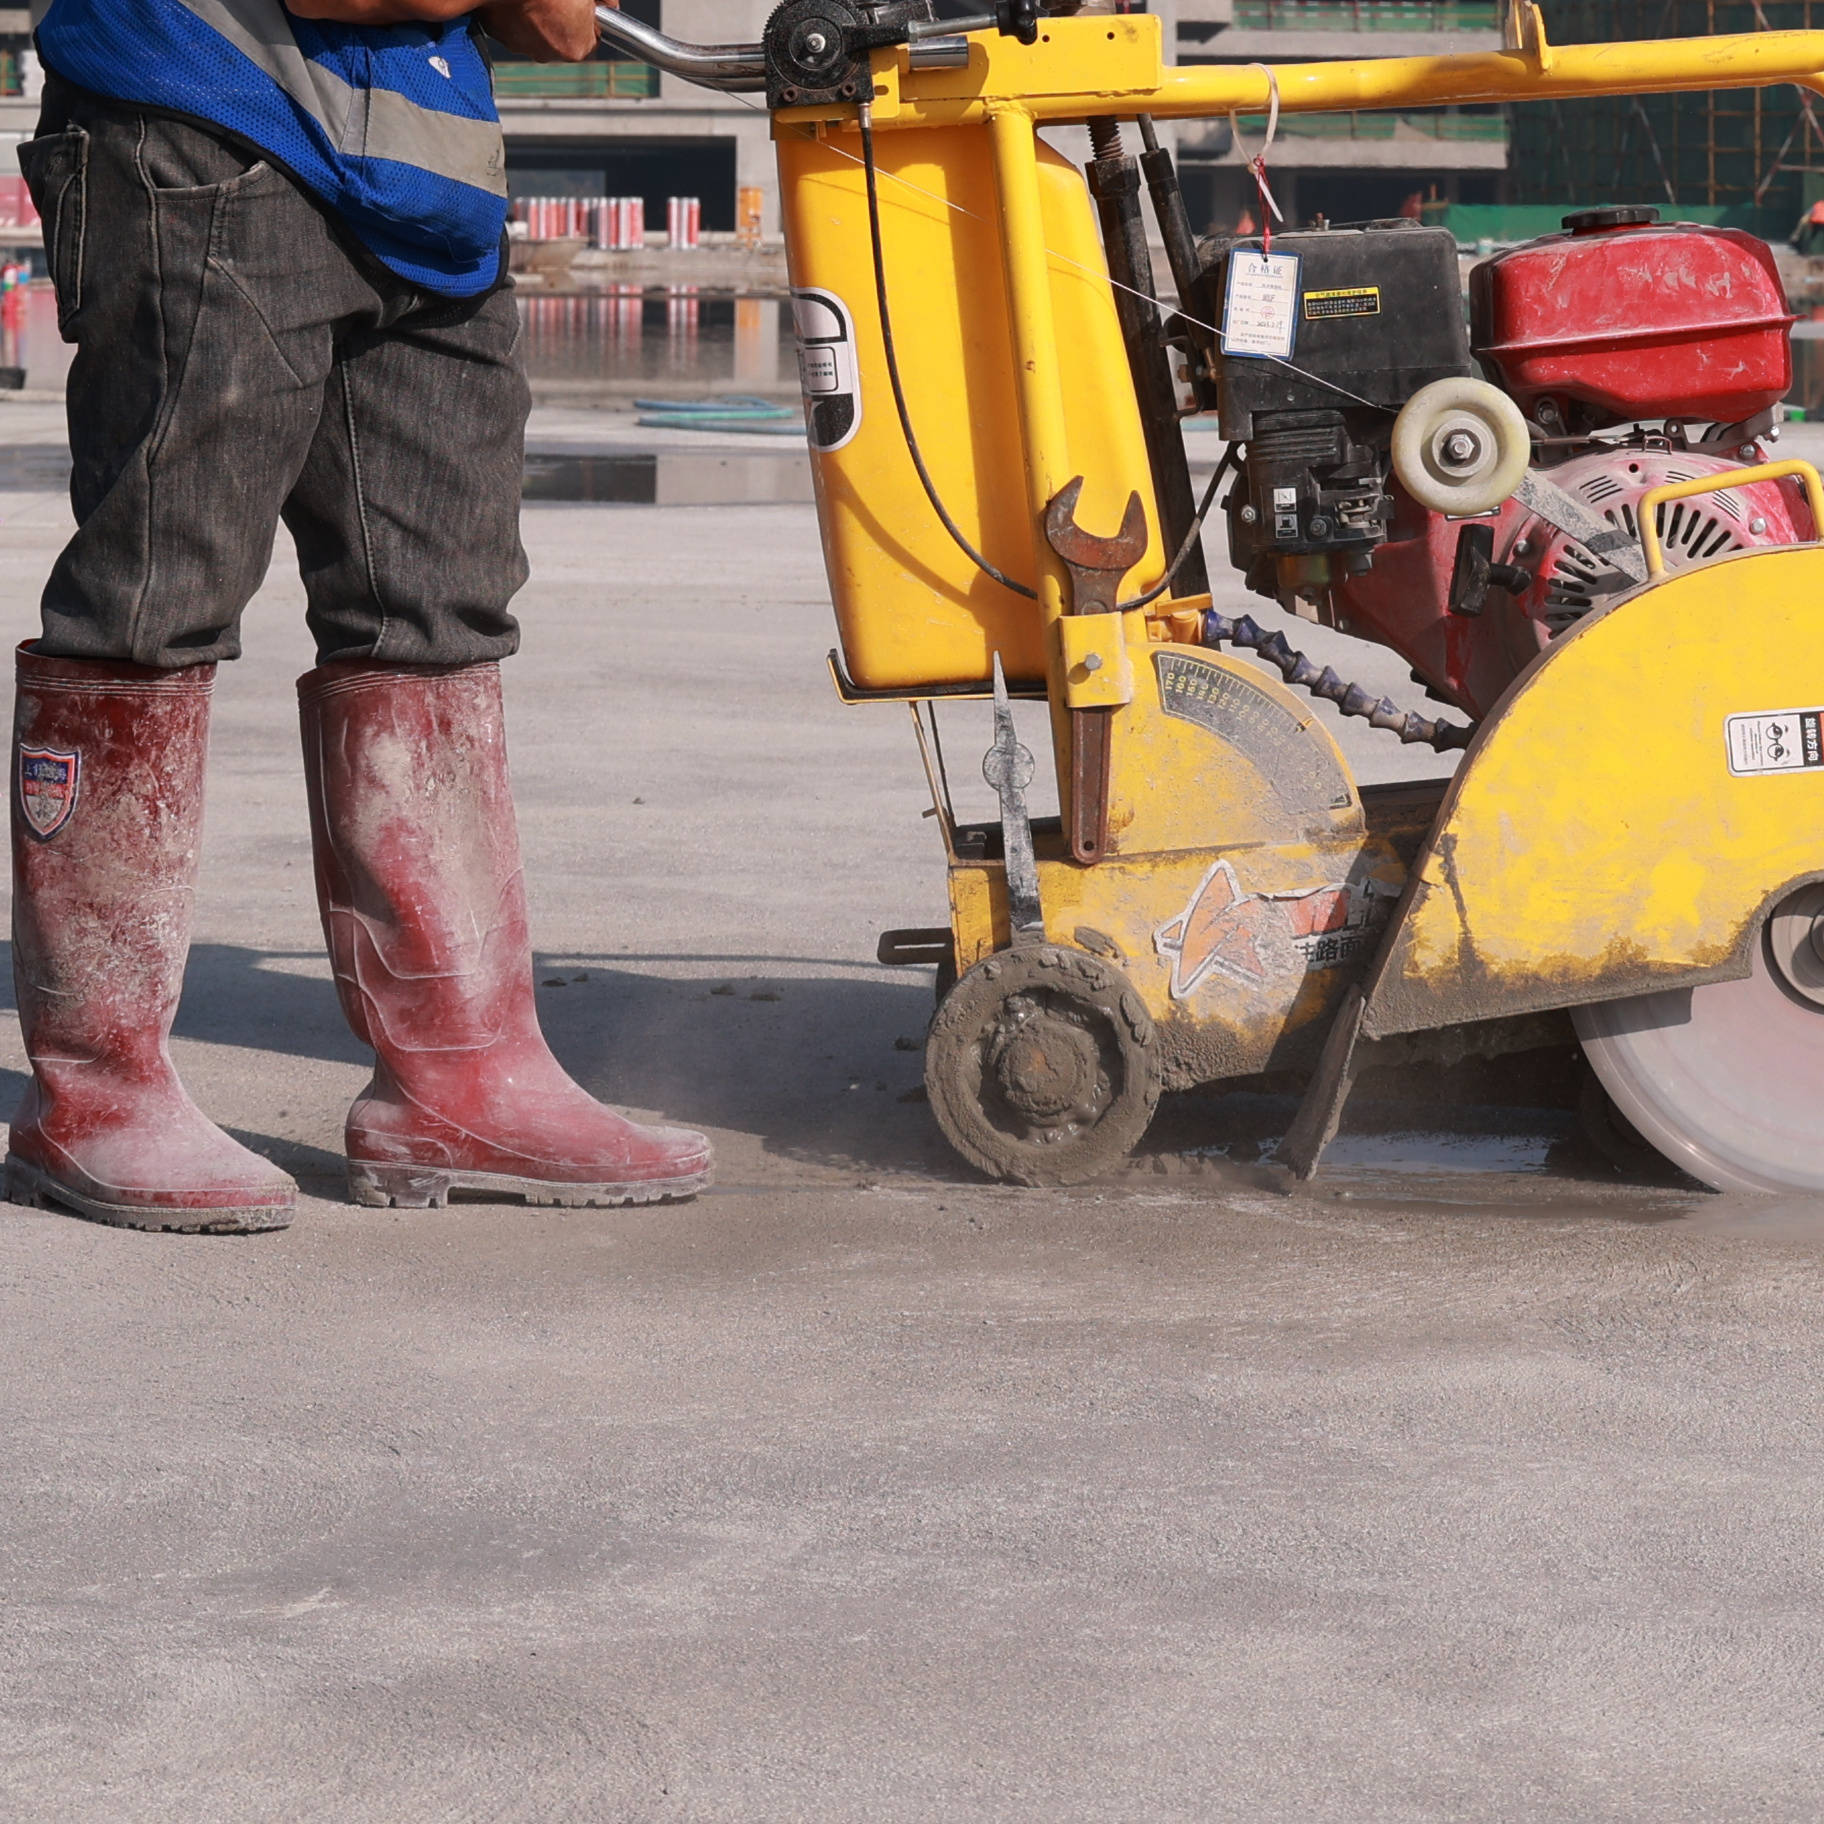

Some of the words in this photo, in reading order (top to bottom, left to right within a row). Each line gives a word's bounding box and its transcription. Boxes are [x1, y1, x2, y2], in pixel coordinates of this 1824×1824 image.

[1165, 672, 1176, 690] 170
[1207, 687, 1220, 705] 130
[1217, 692, 1230, 711] 120
